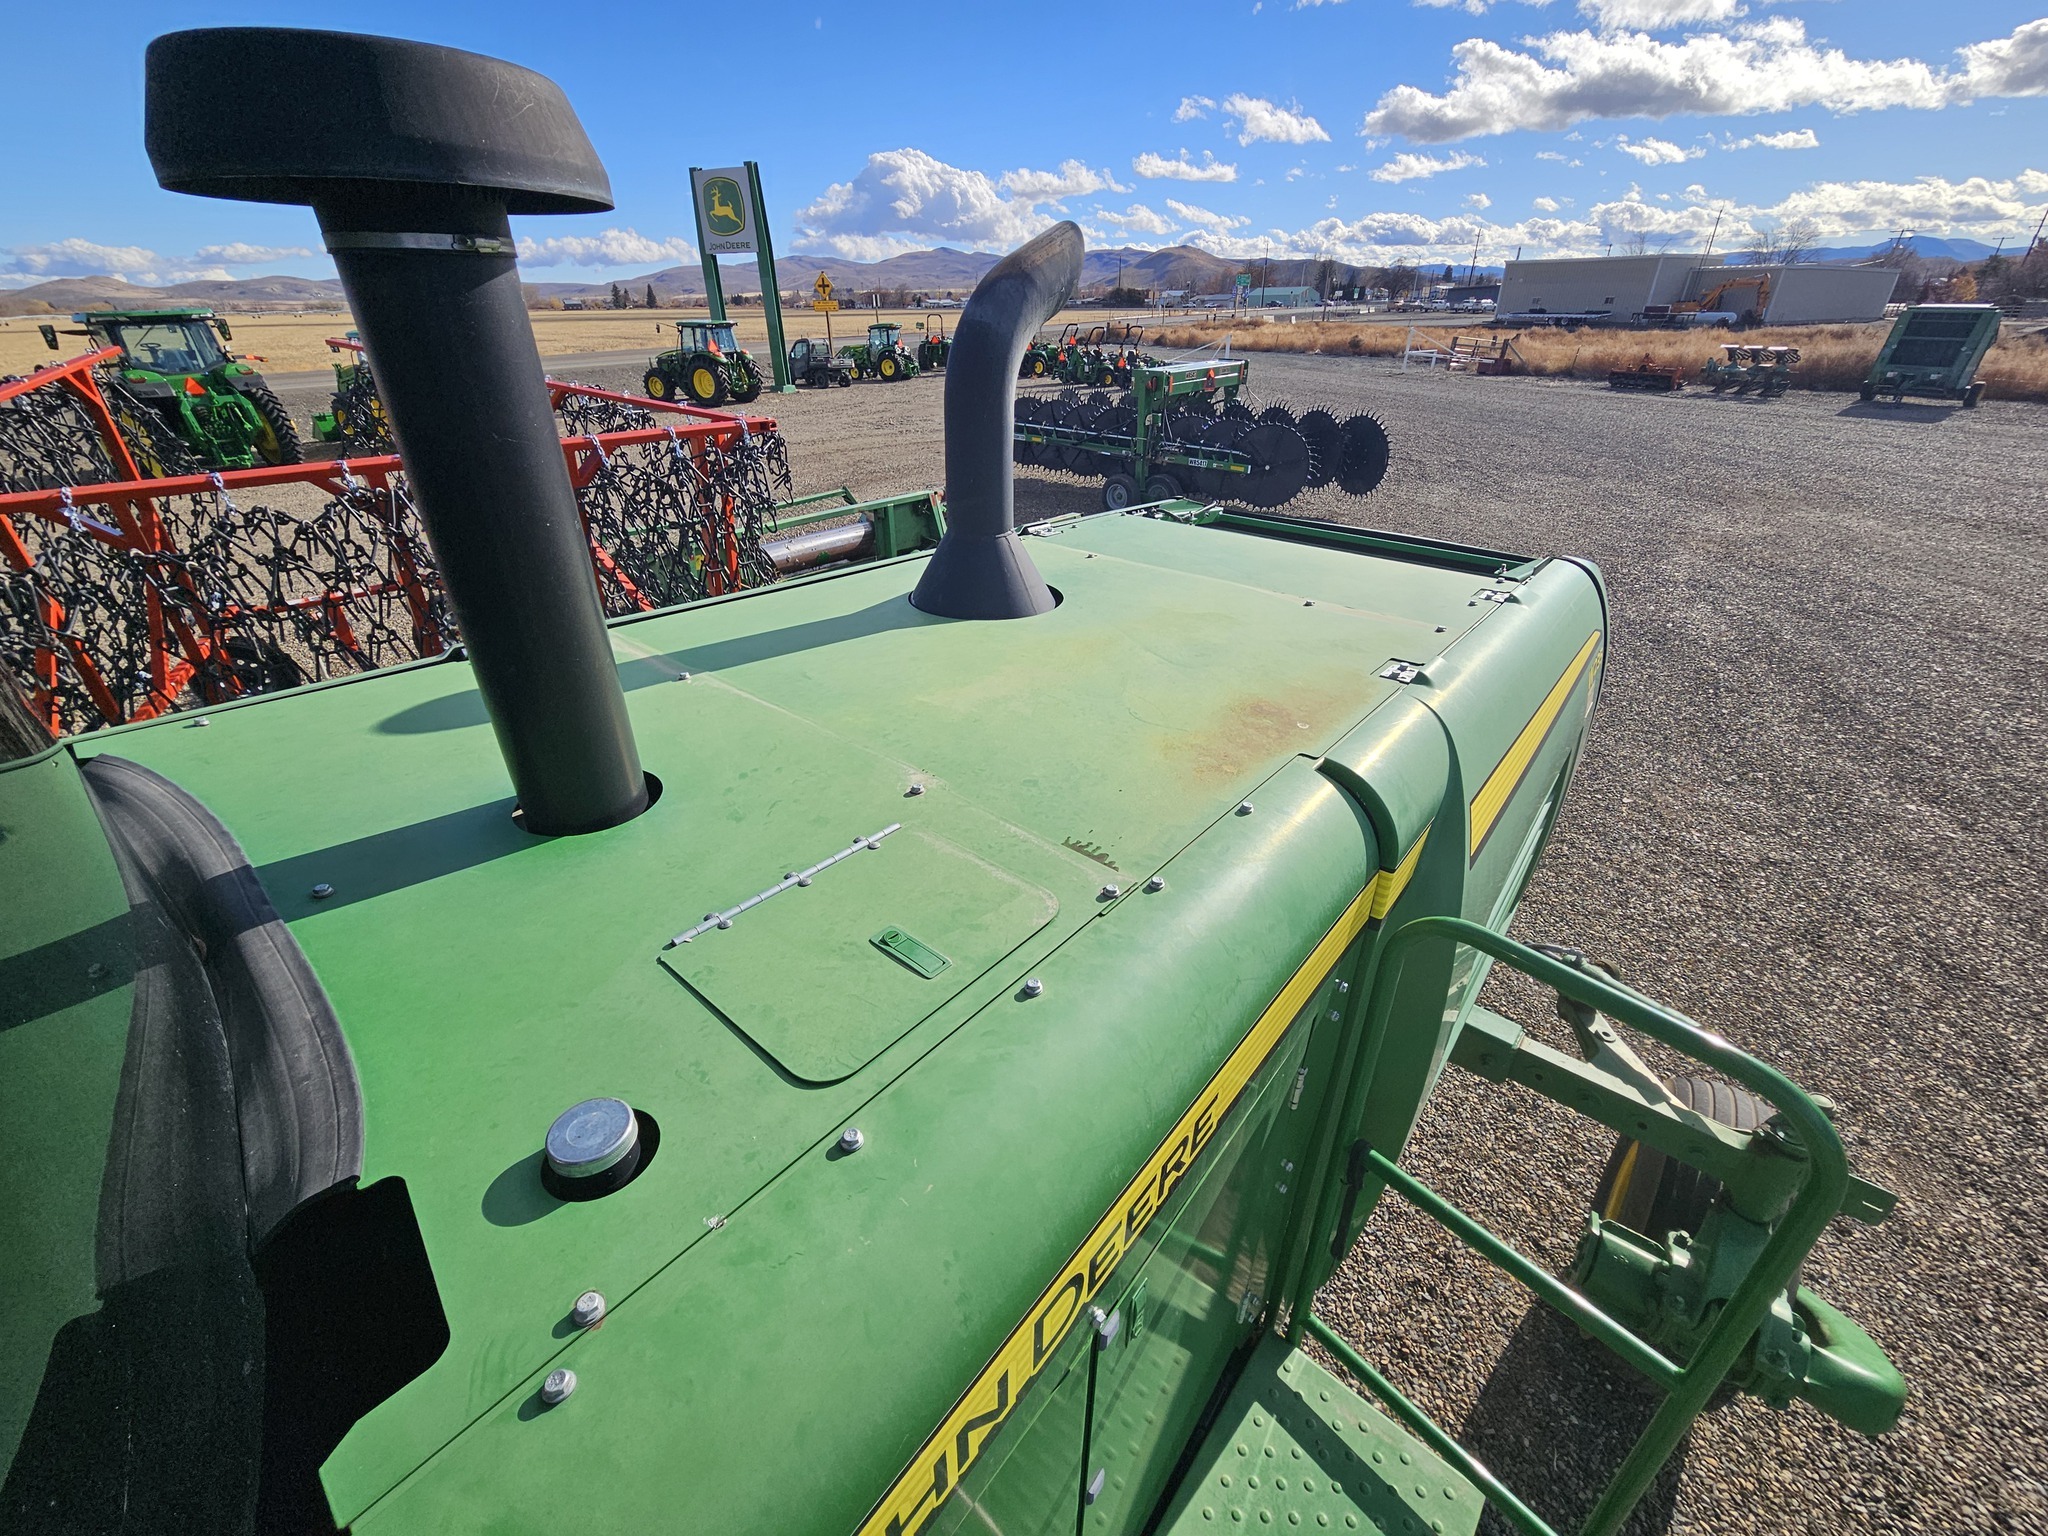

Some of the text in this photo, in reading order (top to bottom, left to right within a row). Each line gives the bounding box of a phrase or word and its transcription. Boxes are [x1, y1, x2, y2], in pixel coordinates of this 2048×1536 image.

[709, 241, 751, 251] JOHN DEERE
[1034, 1093, 1219, 1371] DEERE
